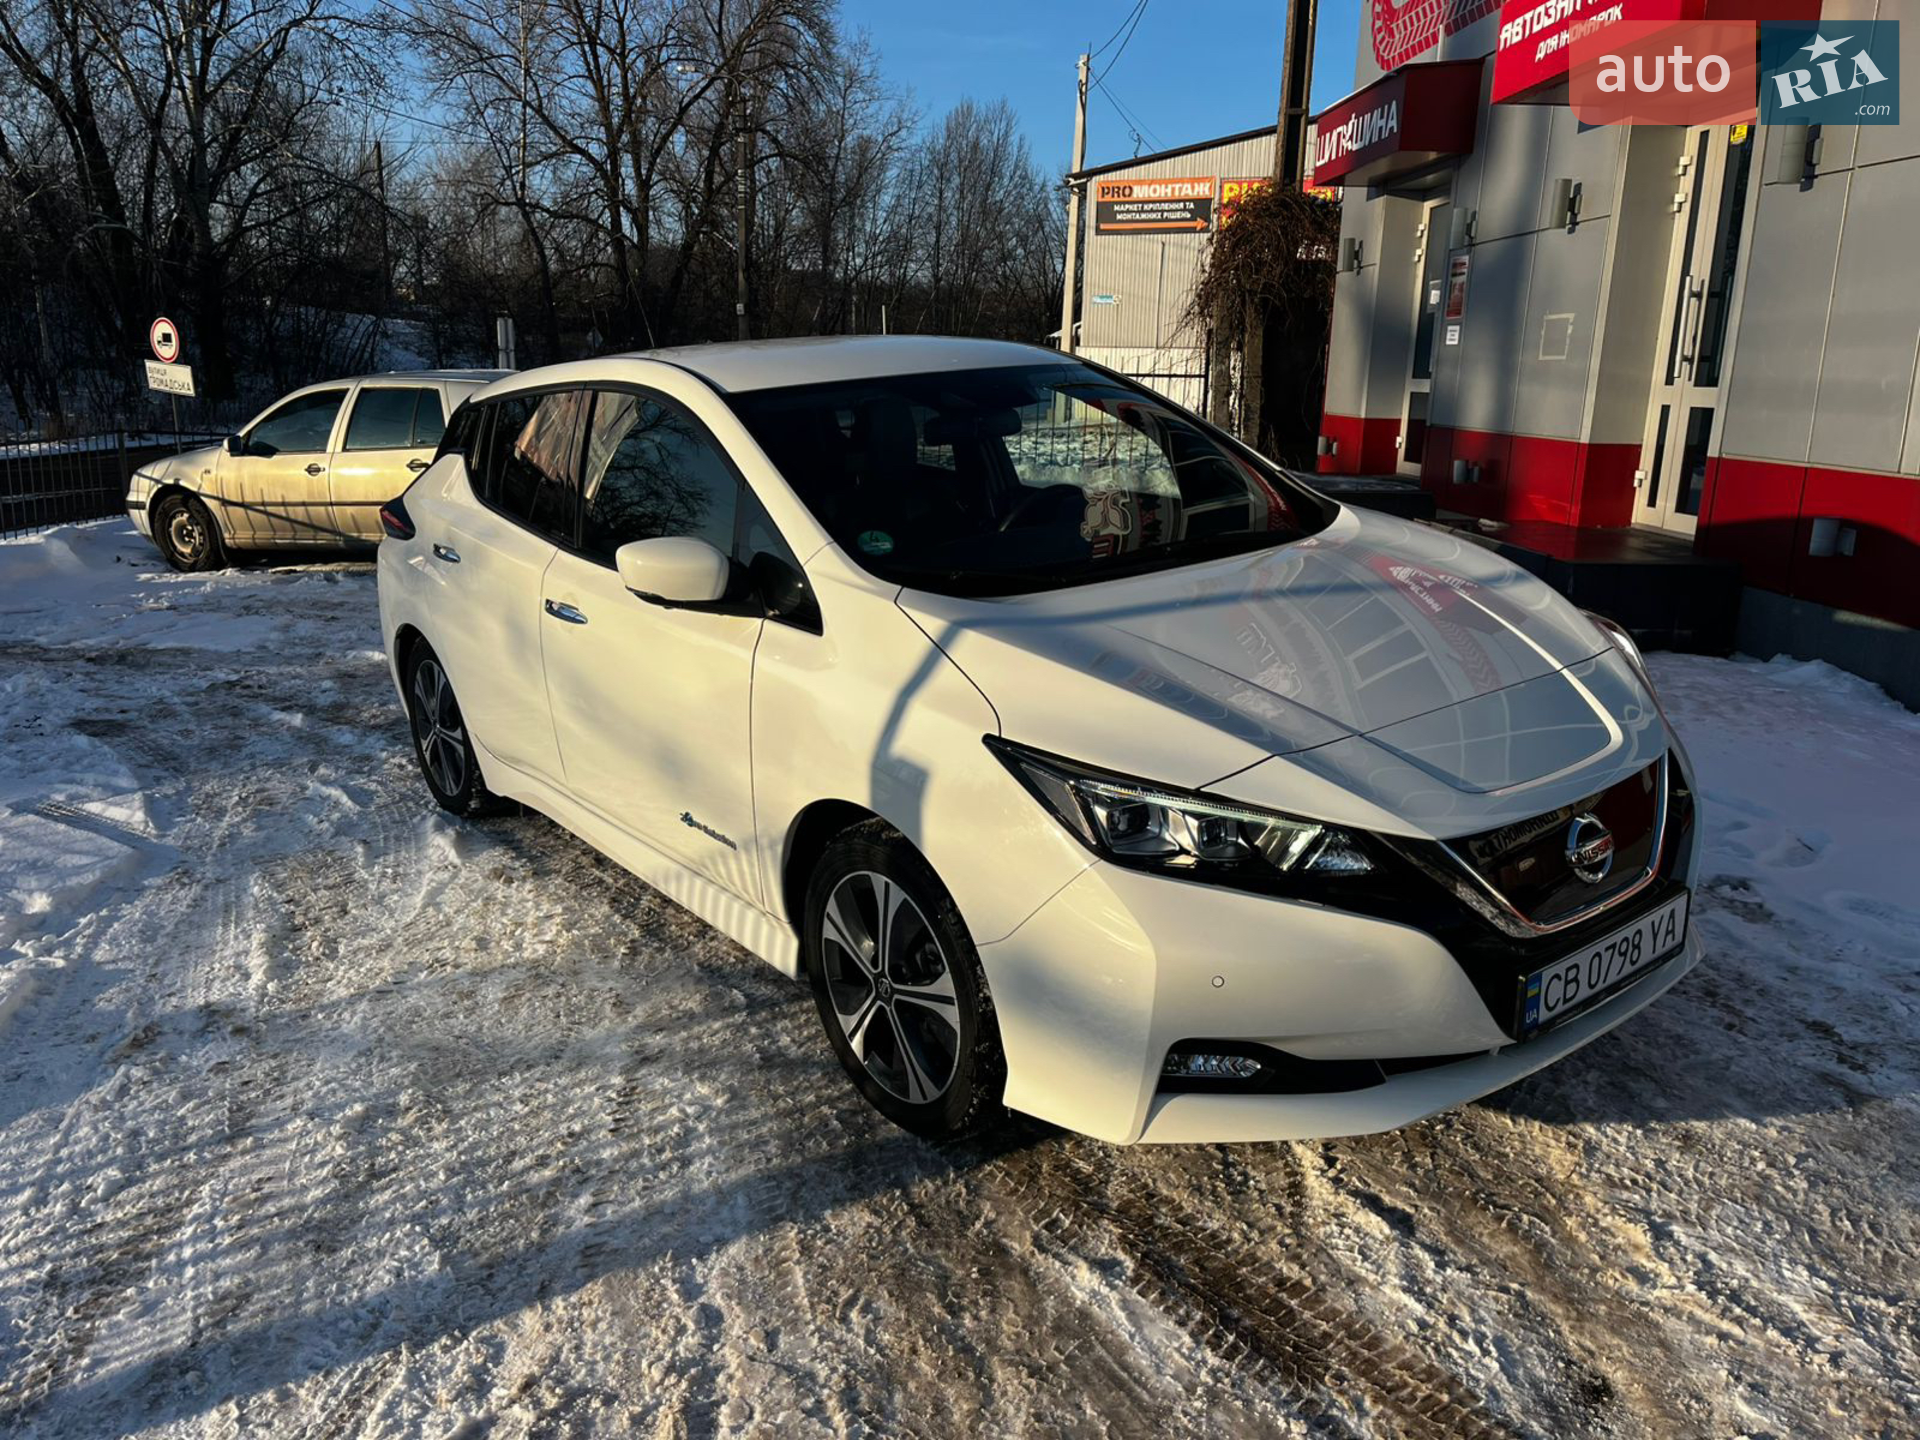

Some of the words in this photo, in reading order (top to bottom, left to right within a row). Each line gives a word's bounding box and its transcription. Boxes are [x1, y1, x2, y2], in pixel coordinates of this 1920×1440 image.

[1535, 33, 1559, 62] ДЛЯ
[1587, 928, 1643, 990] 0798
[1526, 1008, 1538, 1024] UA
